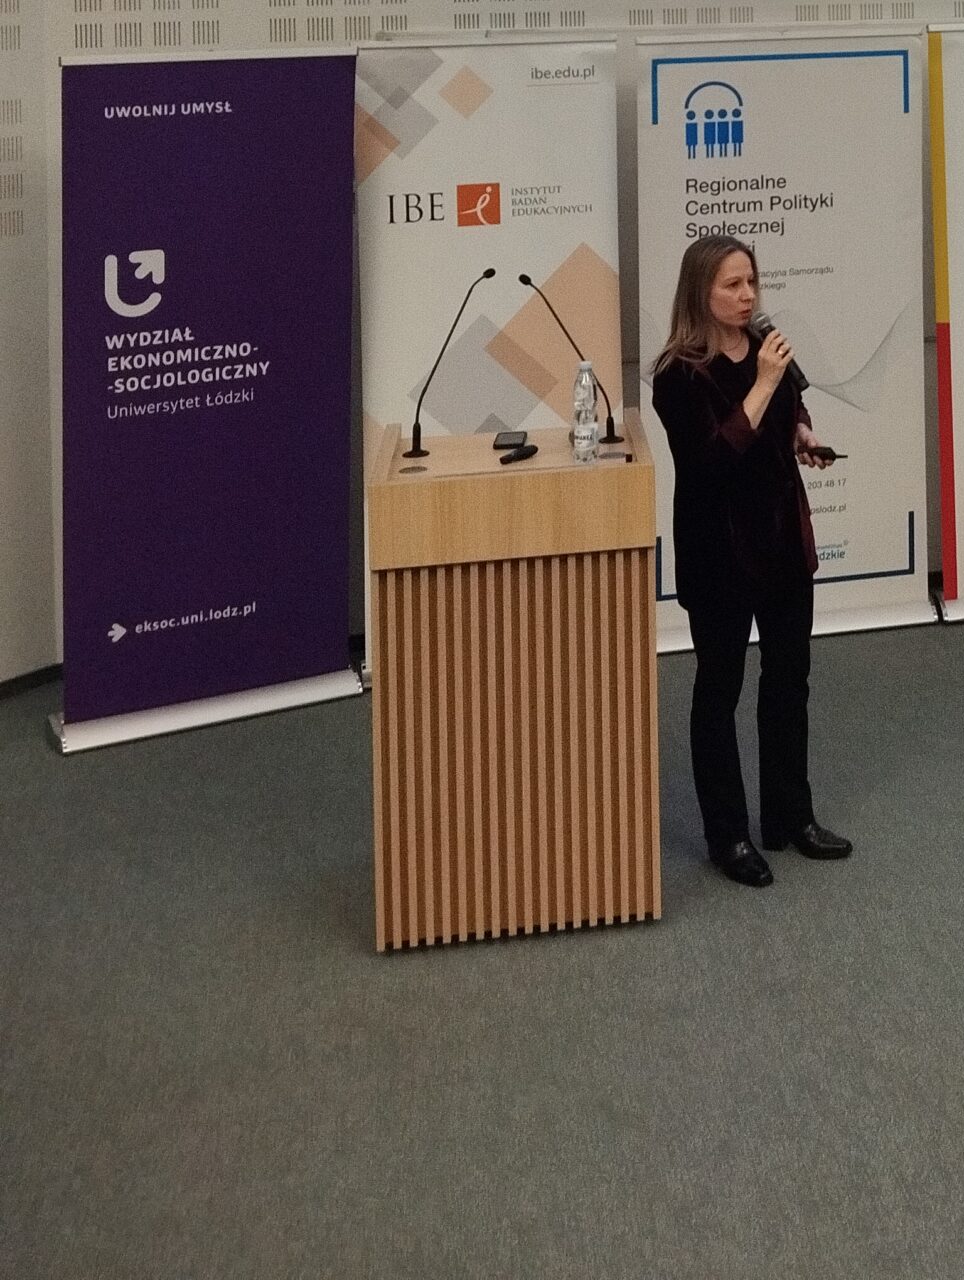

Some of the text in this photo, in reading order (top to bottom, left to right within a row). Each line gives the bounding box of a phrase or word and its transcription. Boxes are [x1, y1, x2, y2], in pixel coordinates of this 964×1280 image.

[530, 65, 595, 80] ibe.edu.pl
[104, 101, 232, 118] UWOLNIJ UMYSŁ
[511, 185, 562, 196] INSTYTUT
[685, 175, 787, 195] Regionalne
[387, 192, 445, 224] IBE
[511, 204, 593, 217] EDUKACYJNYCH
[685, 192, 834, 216] Centrum Polityki
[685, 218, 785, 238] Społecznej
[757, 266, 834, 279] zacyjna Samorządu
[759, 281, 787, 291] zkiego
[105, 327, 195, 351] WYDZIAŁ
[107, 342, 259, 372] EKONOMICZNO-
[107, 361, 270, 394] -SOCJOLOGICZNY
[107, 388, 255, 419] Uniwersytet Łódzki
[810, 504, 847, 515] pslodz.pl
[818, 549, 846, 561] dzkie
[135, 601, 257, 634] eksoc.uni.lodz.pl
